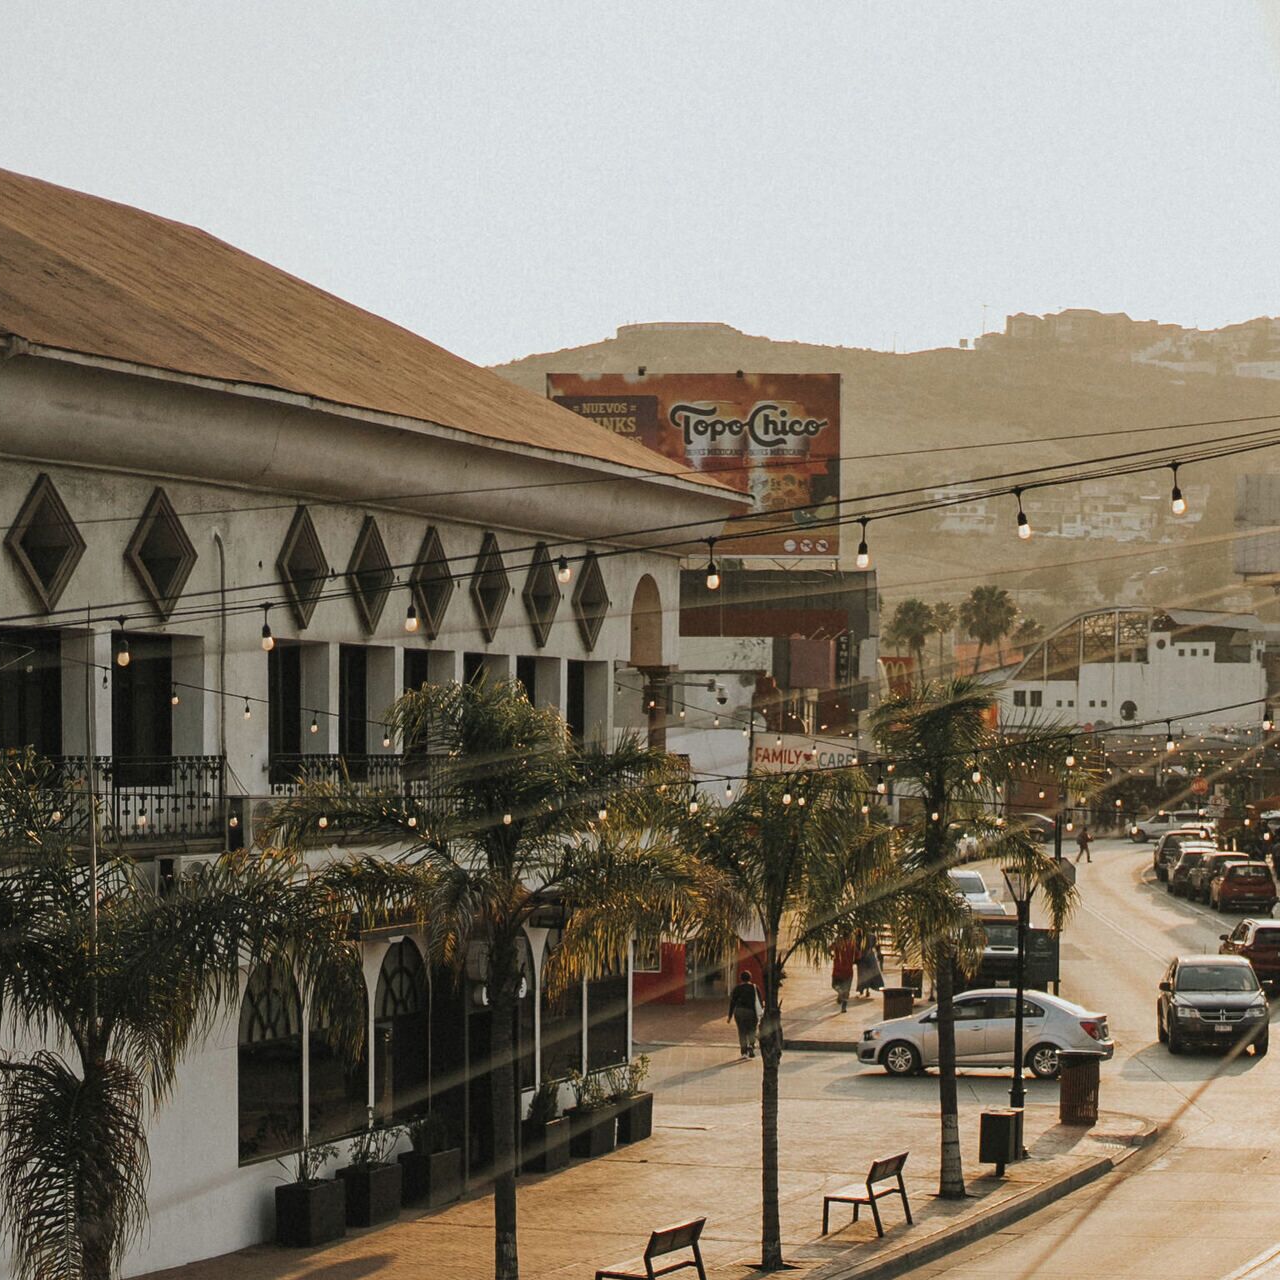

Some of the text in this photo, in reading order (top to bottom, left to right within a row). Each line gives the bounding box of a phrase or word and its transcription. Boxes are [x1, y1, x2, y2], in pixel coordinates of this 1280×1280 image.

[582, 402, 628, 414] NUEVOS
[670, 404, 828, 446] Topo Chico
[755, 747, 854, 768] FAMILY CARE
